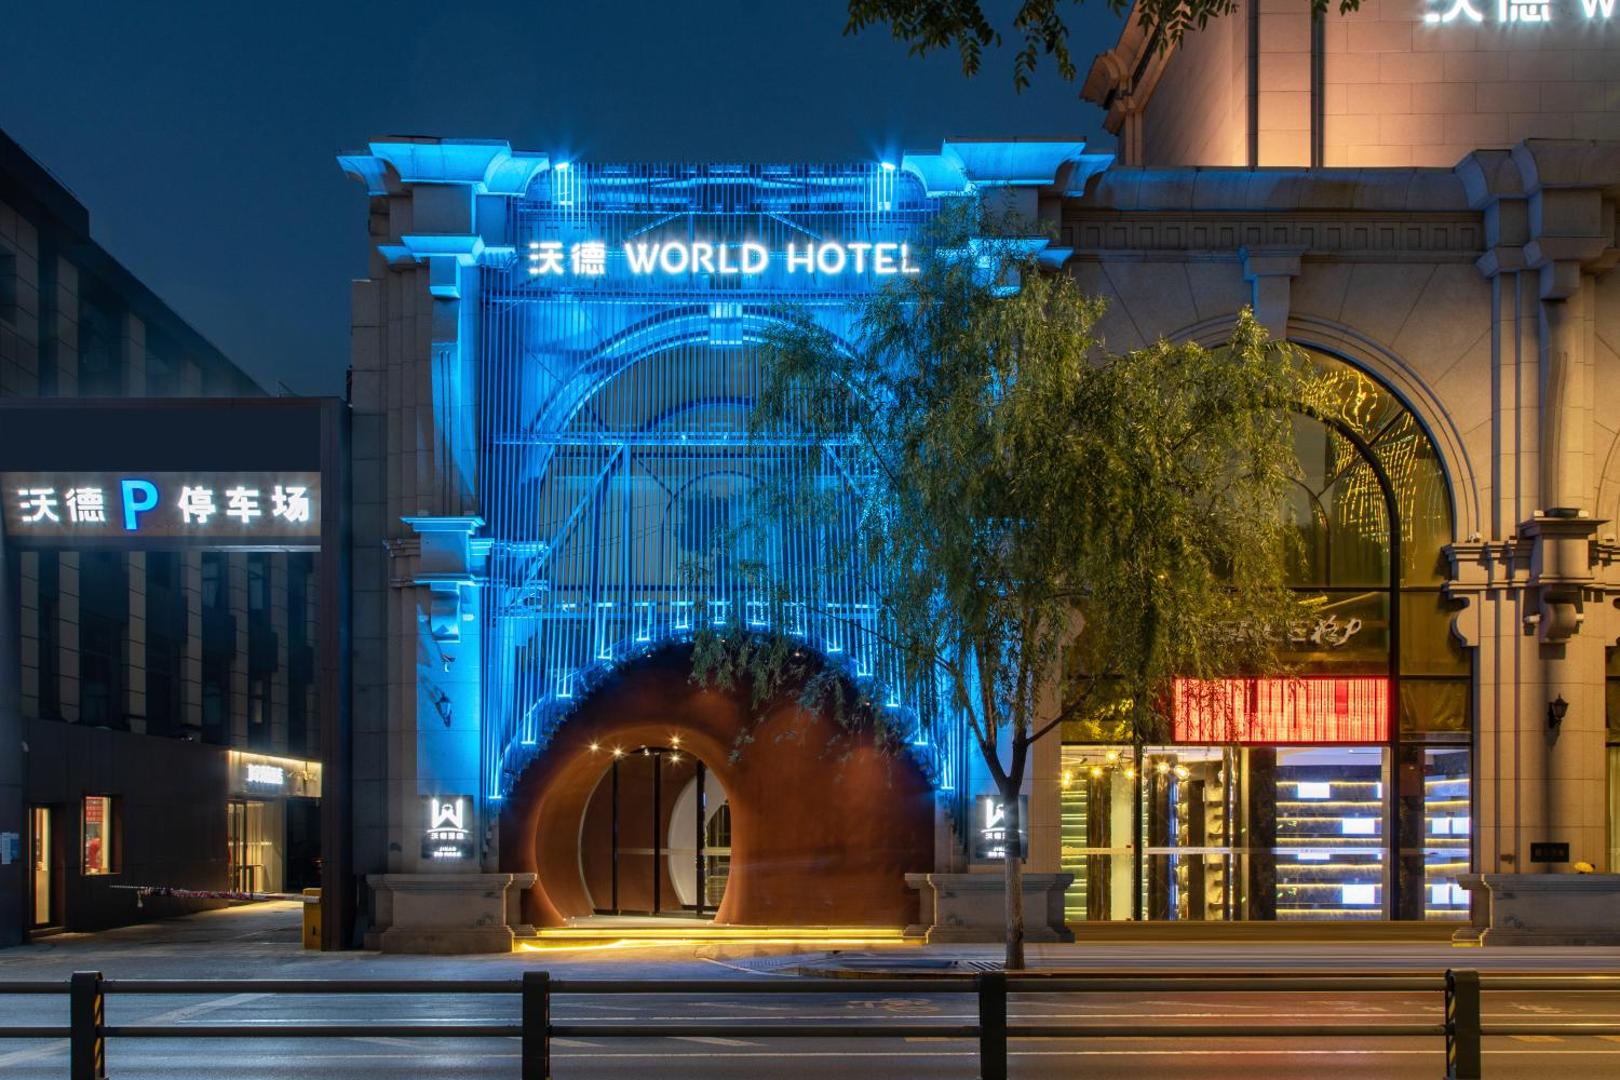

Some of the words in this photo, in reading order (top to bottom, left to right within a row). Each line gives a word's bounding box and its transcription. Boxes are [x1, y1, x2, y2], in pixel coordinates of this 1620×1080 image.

[529, 241, 605, 275] 沃德
[623, 241, 769, 274] WORLD
[787, 242, 920, 274] HOTEL
[17, 487, 106, 523] 沃德
[120, 478, 159, 531] P
[177, 485, 310, 524] 停车场
